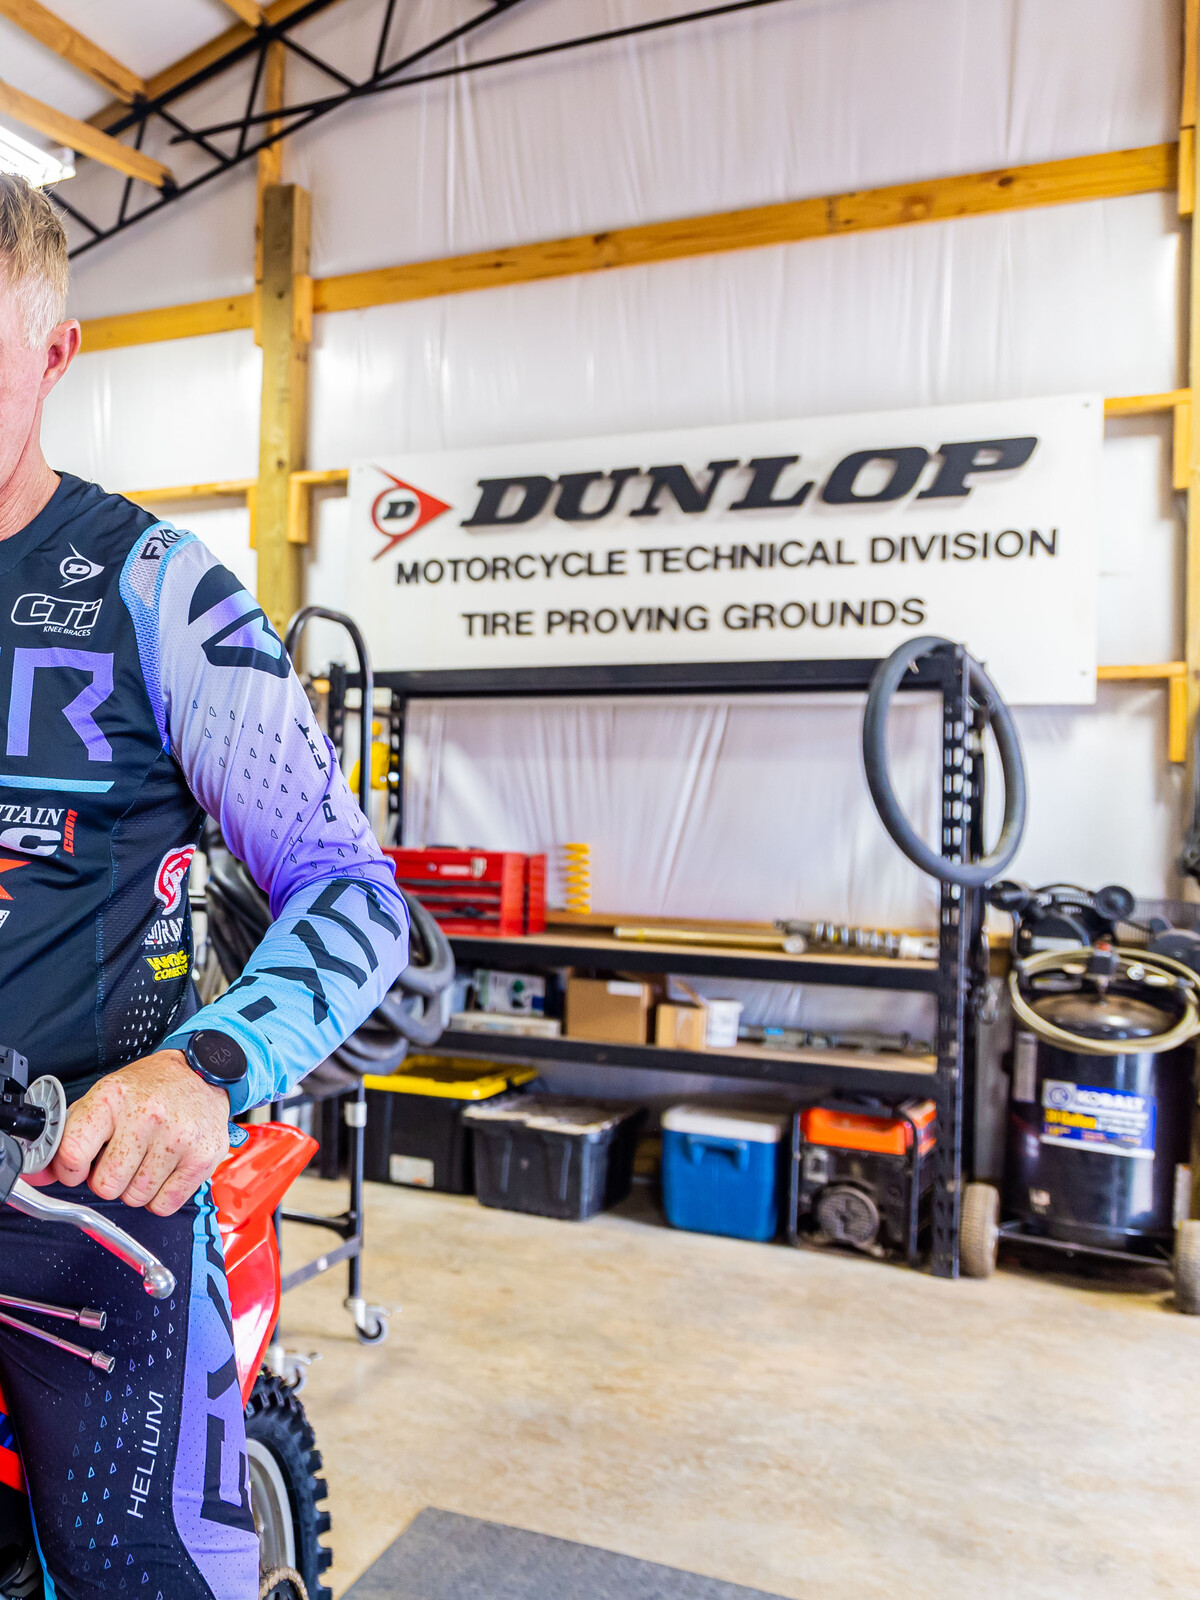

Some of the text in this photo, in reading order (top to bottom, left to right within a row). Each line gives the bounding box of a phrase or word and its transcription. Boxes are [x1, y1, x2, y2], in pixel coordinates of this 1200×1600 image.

[459, 436, 1039, 528] DUNLOP
[383, 500, 416, 520] D
[396, 528, 1059, 586] MOTORCYCLE TECHNICAL DIVISION
[43, 625, 92, 637] KNEE BRACES
[462, 598, 927, 637] TIRE PROVING GROUNDS
[126, 1391, 164, 1519] HELIUM
